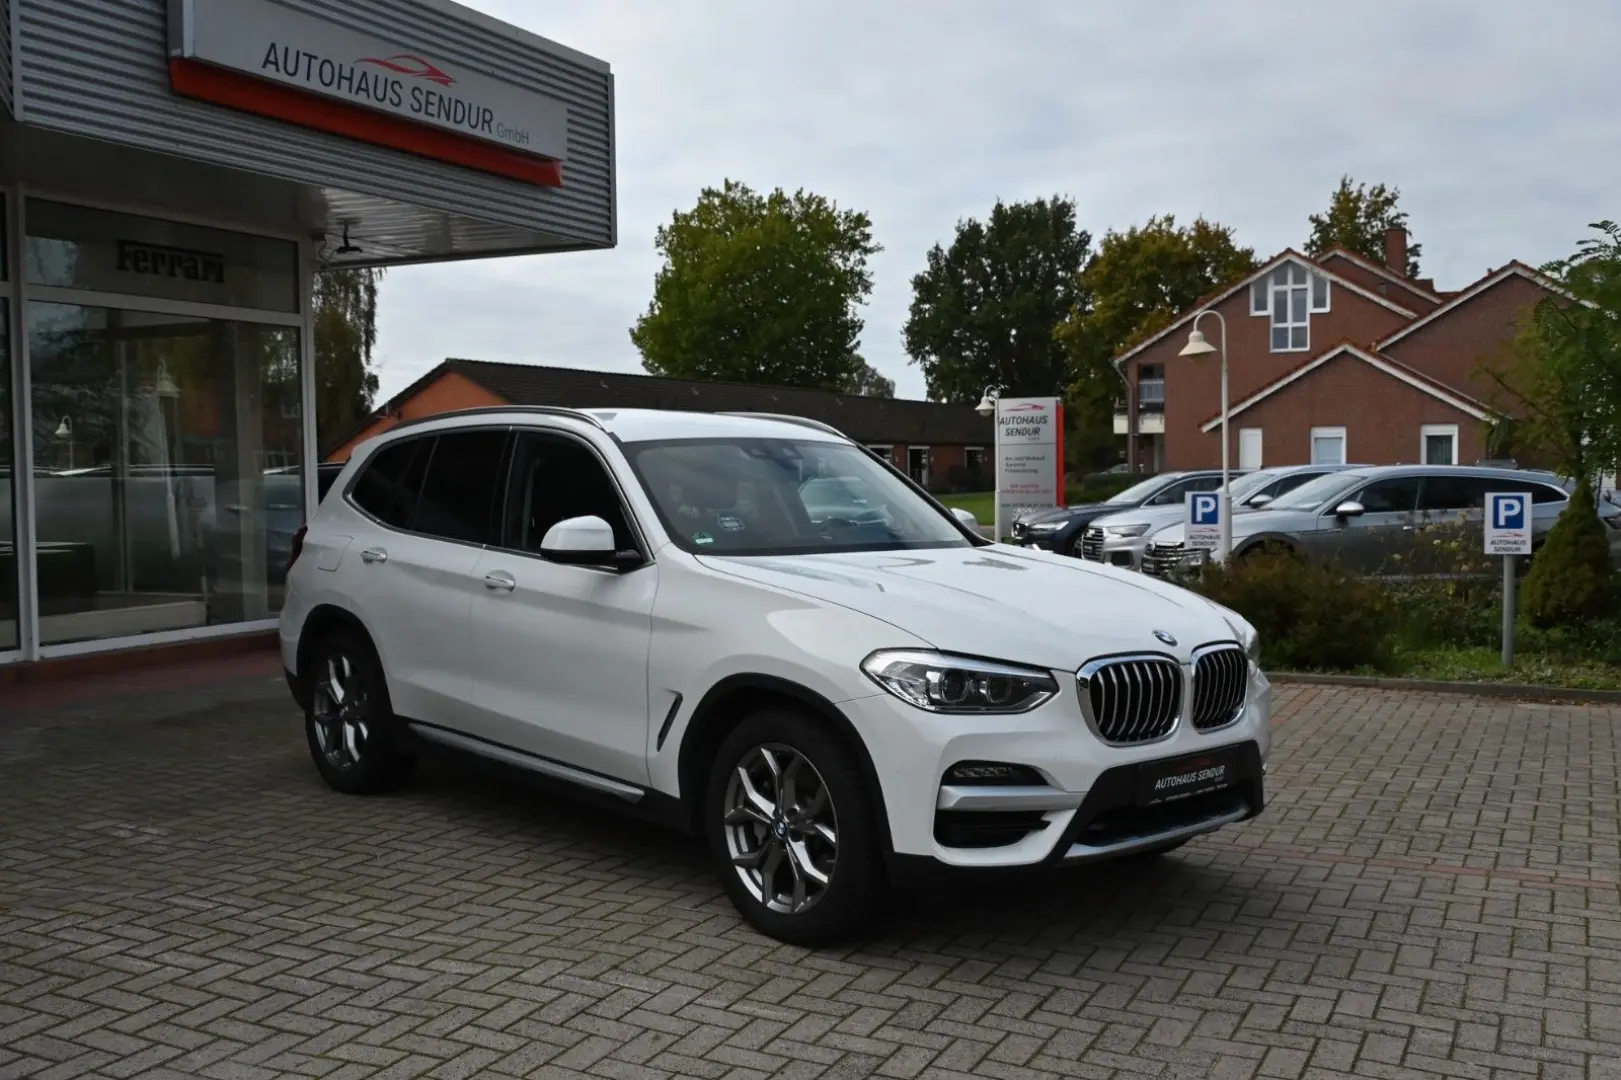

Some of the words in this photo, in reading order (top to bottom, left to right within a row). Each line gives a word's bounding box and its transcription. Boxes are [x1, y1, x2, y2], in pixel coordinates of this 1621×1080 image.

[261, 42, 403, 107] AUTOHAUS
[410, 86, 494, 134] SENDUR
[496, 122, 529, 145] GmbH
[116, 239, 225, 283] Ferrari
[1000, 415, 1049, 426] AUTOHAUS
[1005, 427, 1041, 437] SENDUR
[1196, 496, 1216, 522] P
[1498, 499, 1521, 526] P
[1154, 771, 1198, 790] AUTOHAUS
[1198, 765, 1226, 781] SENDUR
